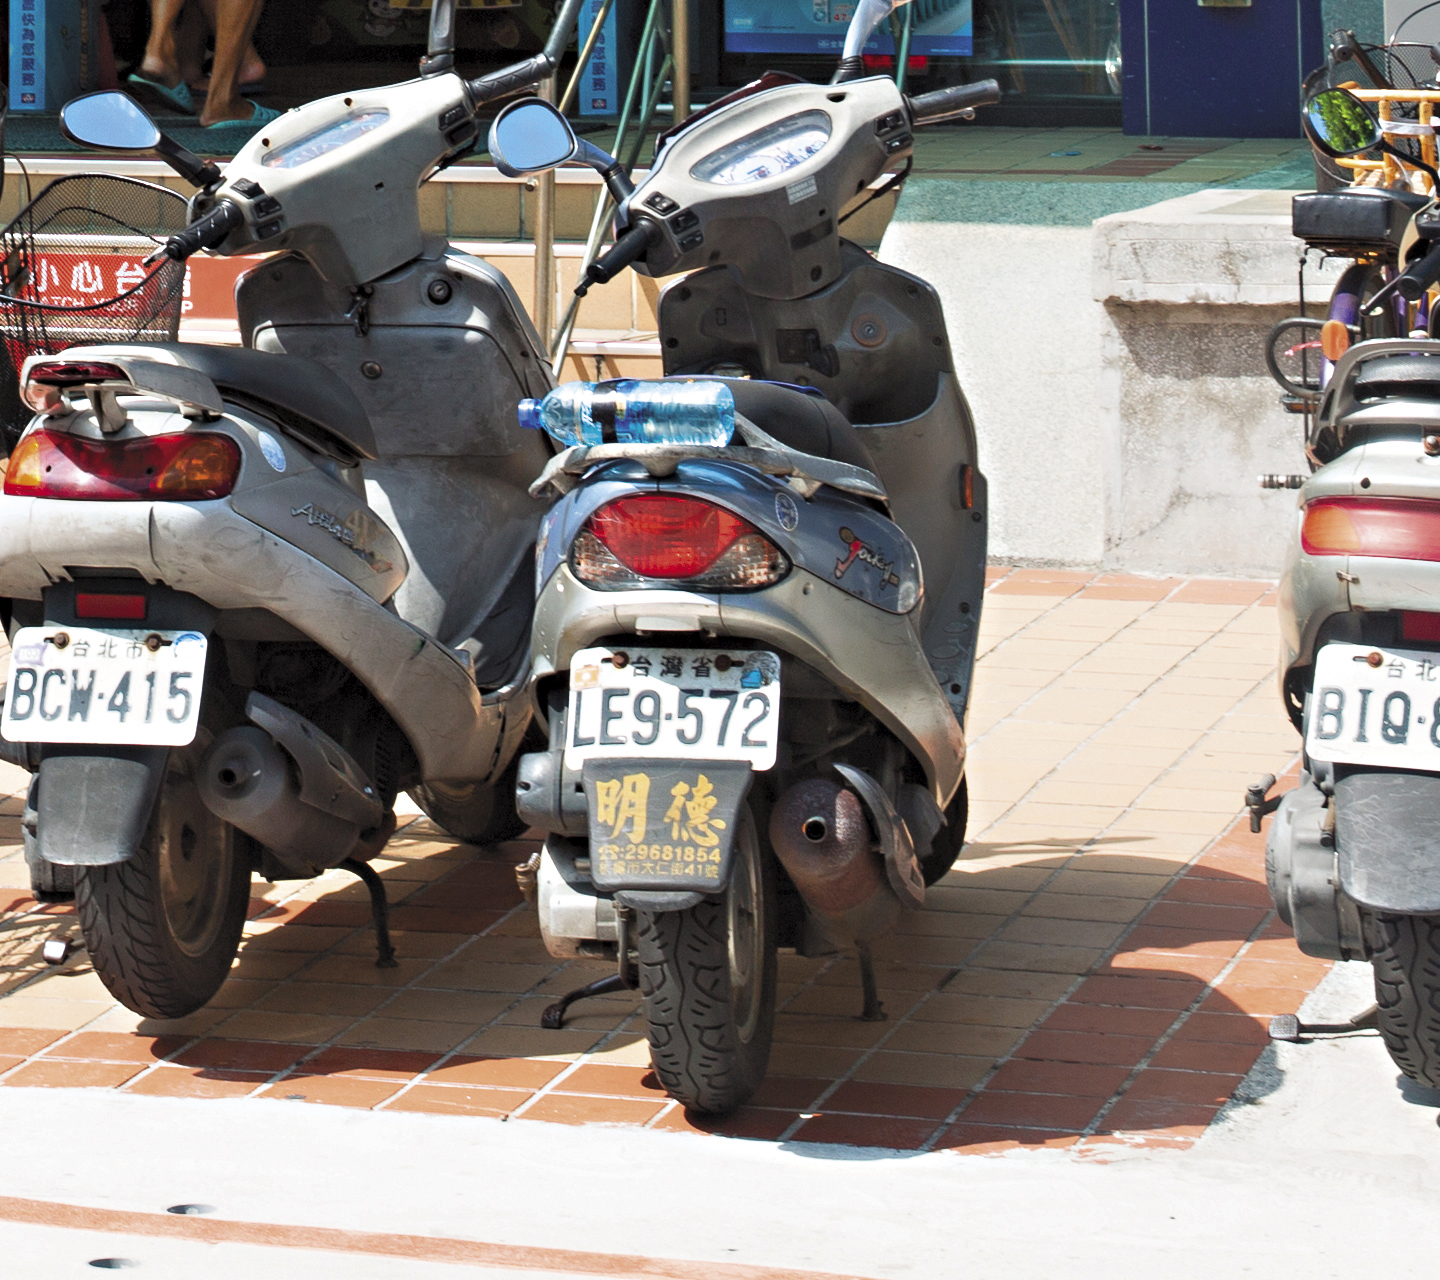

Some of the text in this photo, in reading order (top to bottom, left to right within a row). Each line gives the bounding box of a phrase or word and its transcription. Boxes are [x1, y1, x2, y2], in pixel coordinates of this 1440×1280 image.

[72, 636, 147, 660] 台北市
[631, 654, 713, 679] 台灣省
[595, 771, 727, 848] 明德
